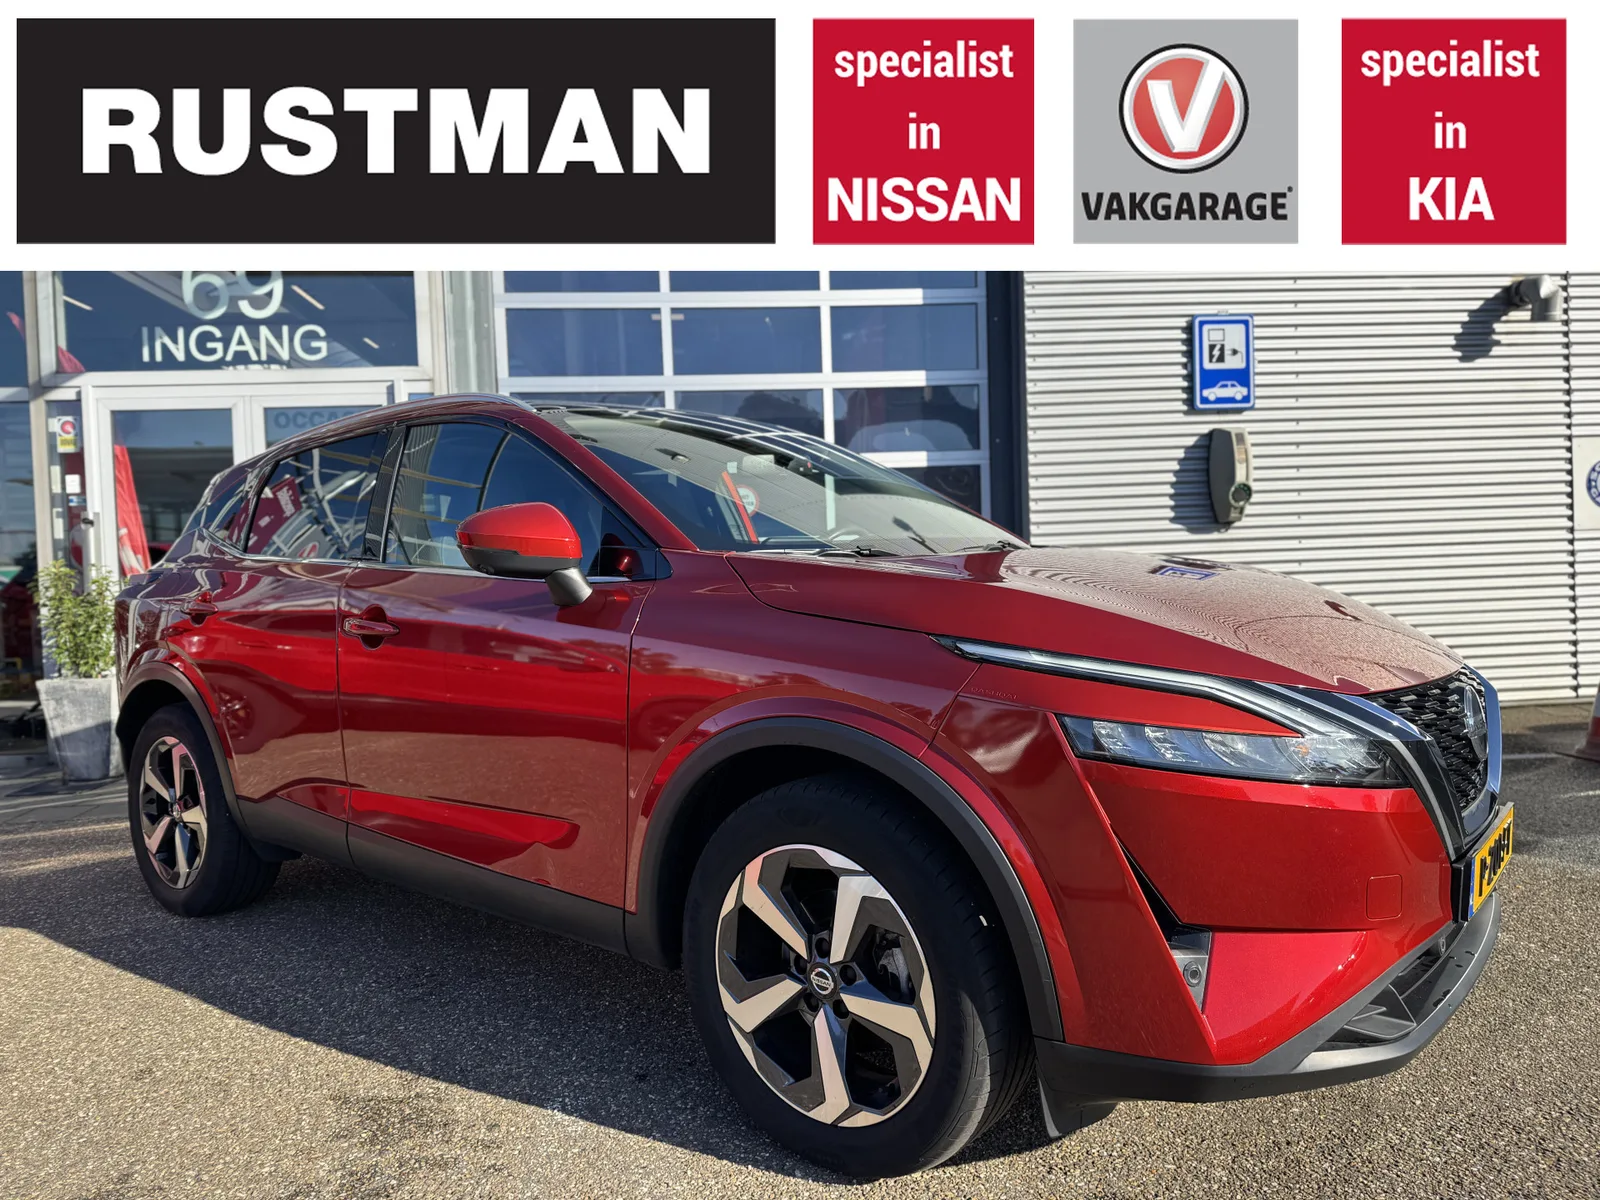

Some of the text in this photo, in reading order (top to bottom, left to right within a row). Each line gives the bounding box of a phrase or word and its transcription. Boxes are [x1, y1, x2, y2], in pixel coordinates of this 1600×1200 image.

[181, 271, 284, 320] 69
[141, 324, 328, 363] INGANG
[273, 411, 355, 429] OCC
[811, 976, 832, 988] NISSAN
